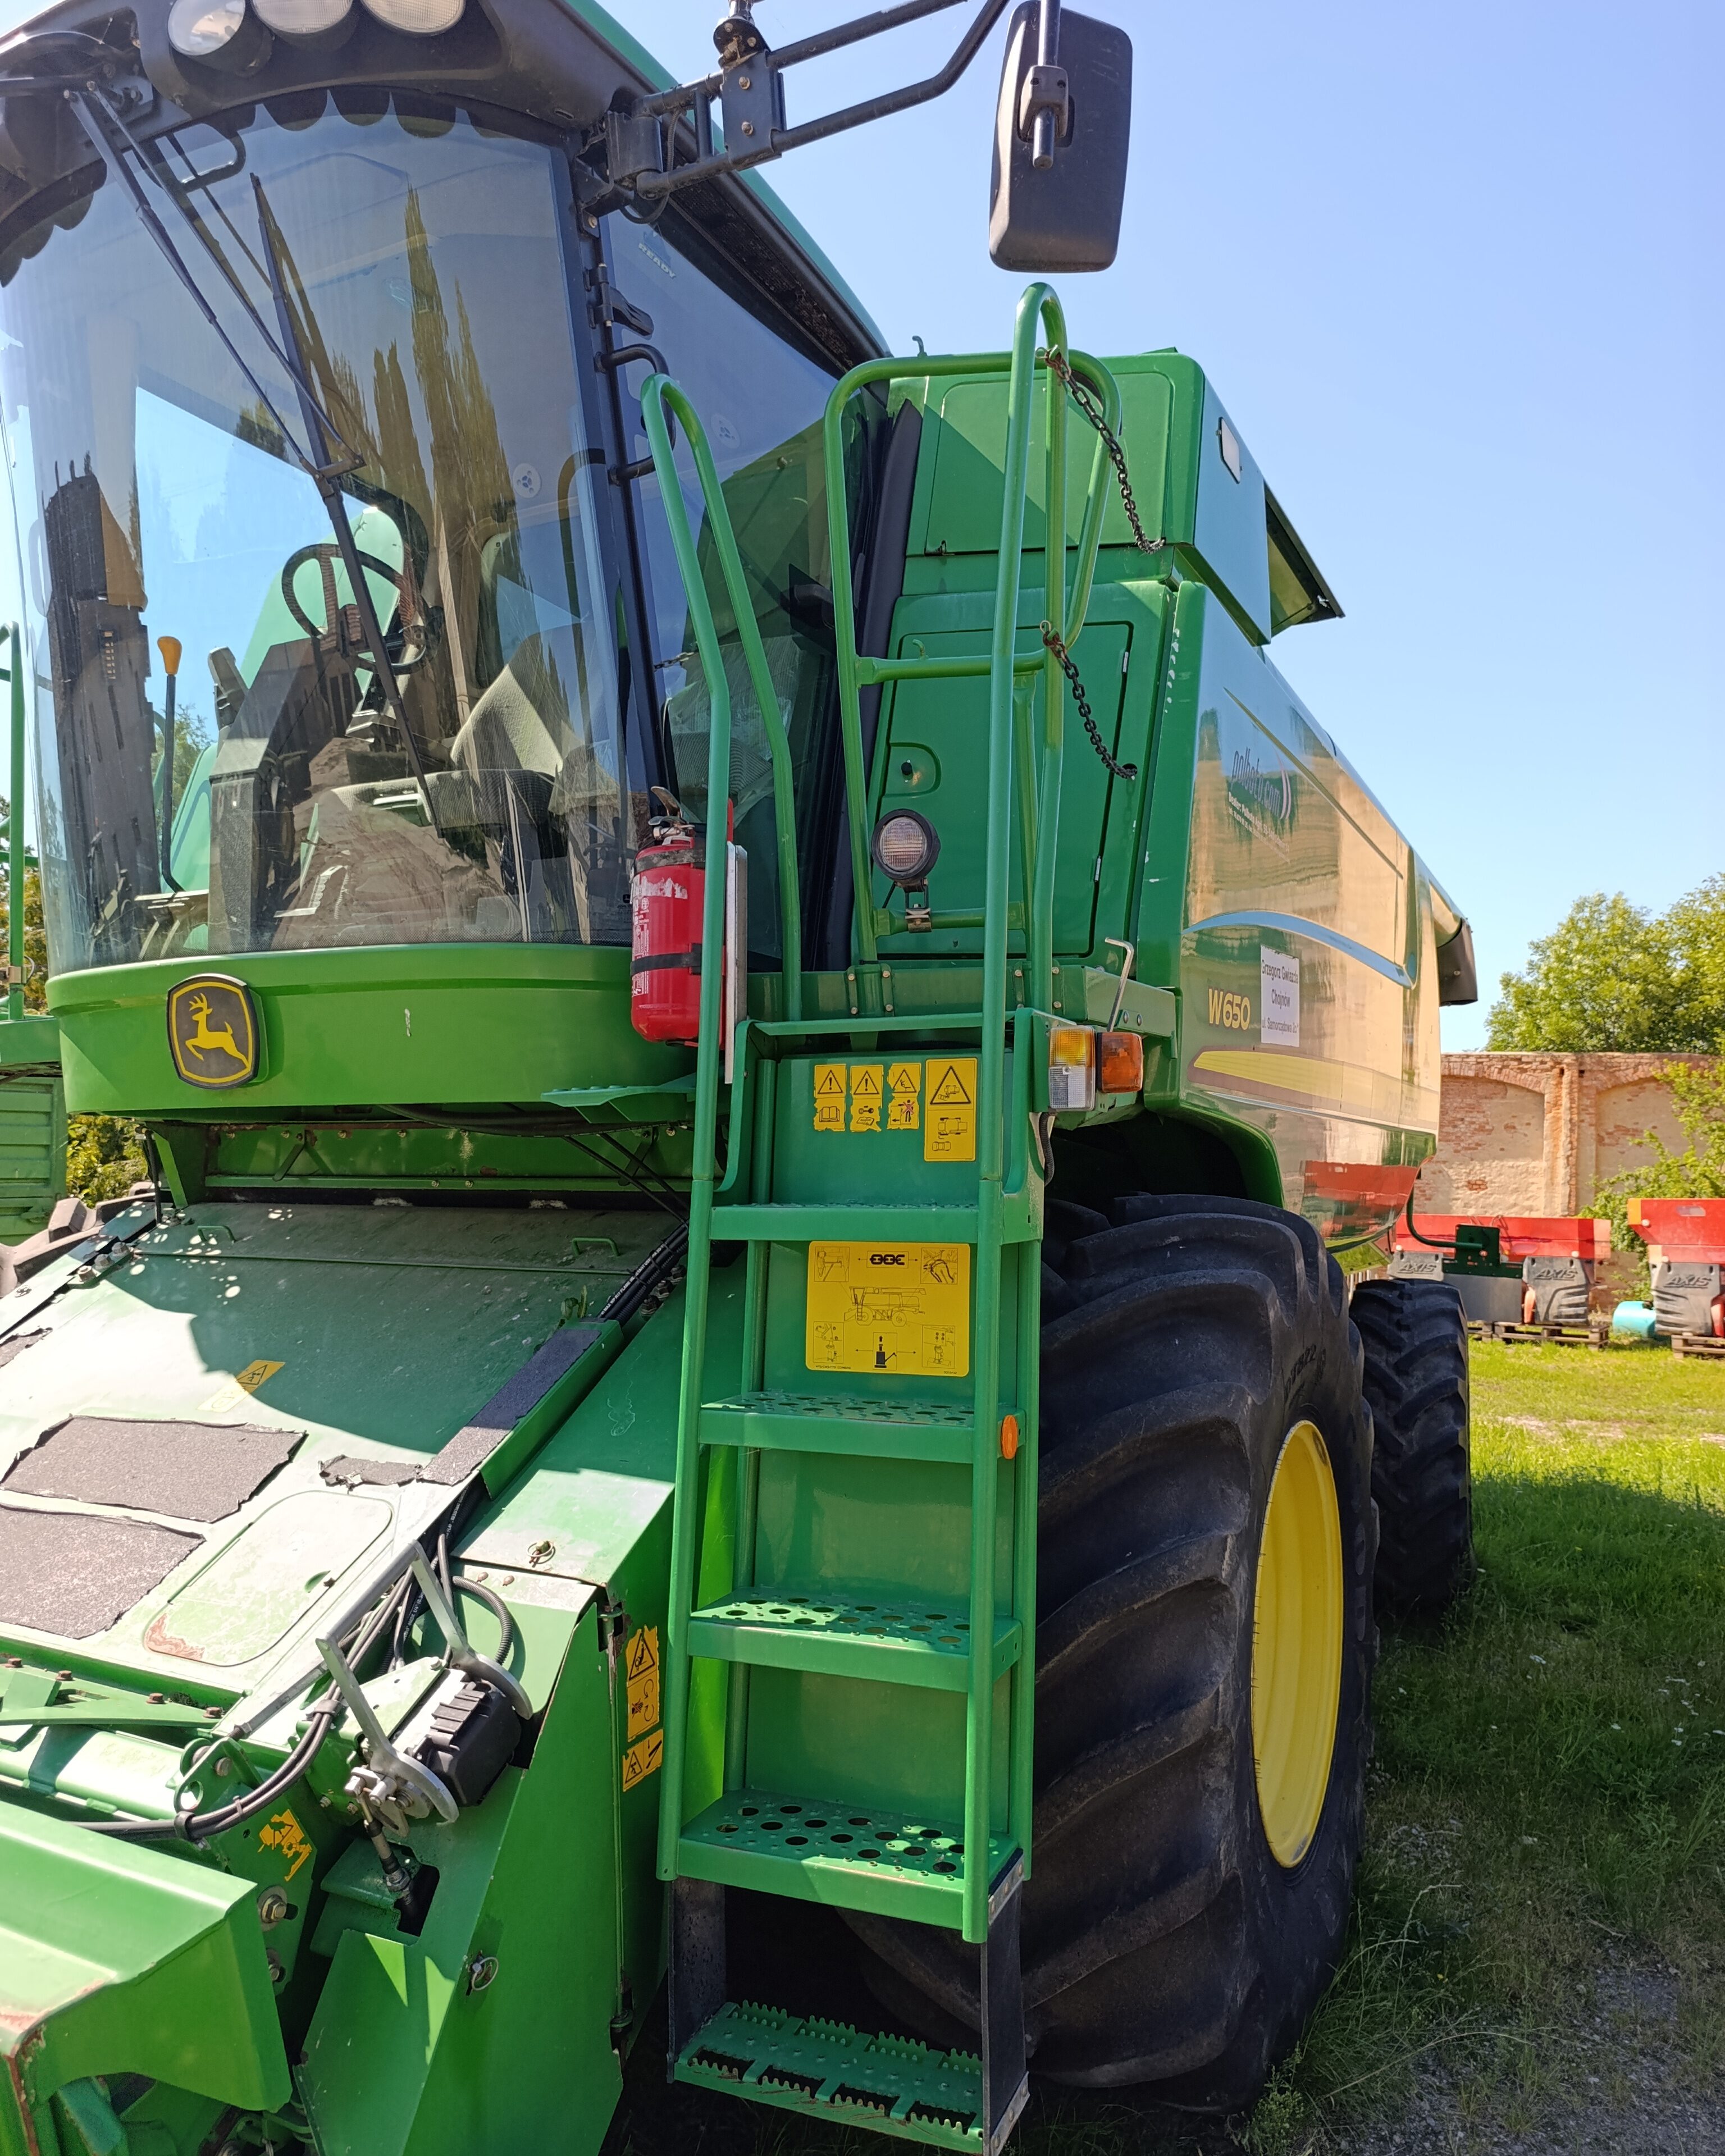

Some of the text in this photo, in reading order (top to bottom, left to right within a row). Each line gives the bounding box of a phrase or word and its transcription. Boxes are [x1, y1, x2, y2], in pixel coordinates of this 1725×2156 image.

[638, 243, 676, 279] READY
[1261, 959, 1298, 984] Grzegorz Gwiazda
[1271, 988, 1290, 1010] Chojnów
[1208, 987, 1251, 1031] W650
[1399, 1263, 1436, 1273] AXIS
[1535, 1268, 1577, 1280] AXIS
[620, 1281, 631, 1292] FLAME
[1666, 1275, 1712, 1287] AXIS
